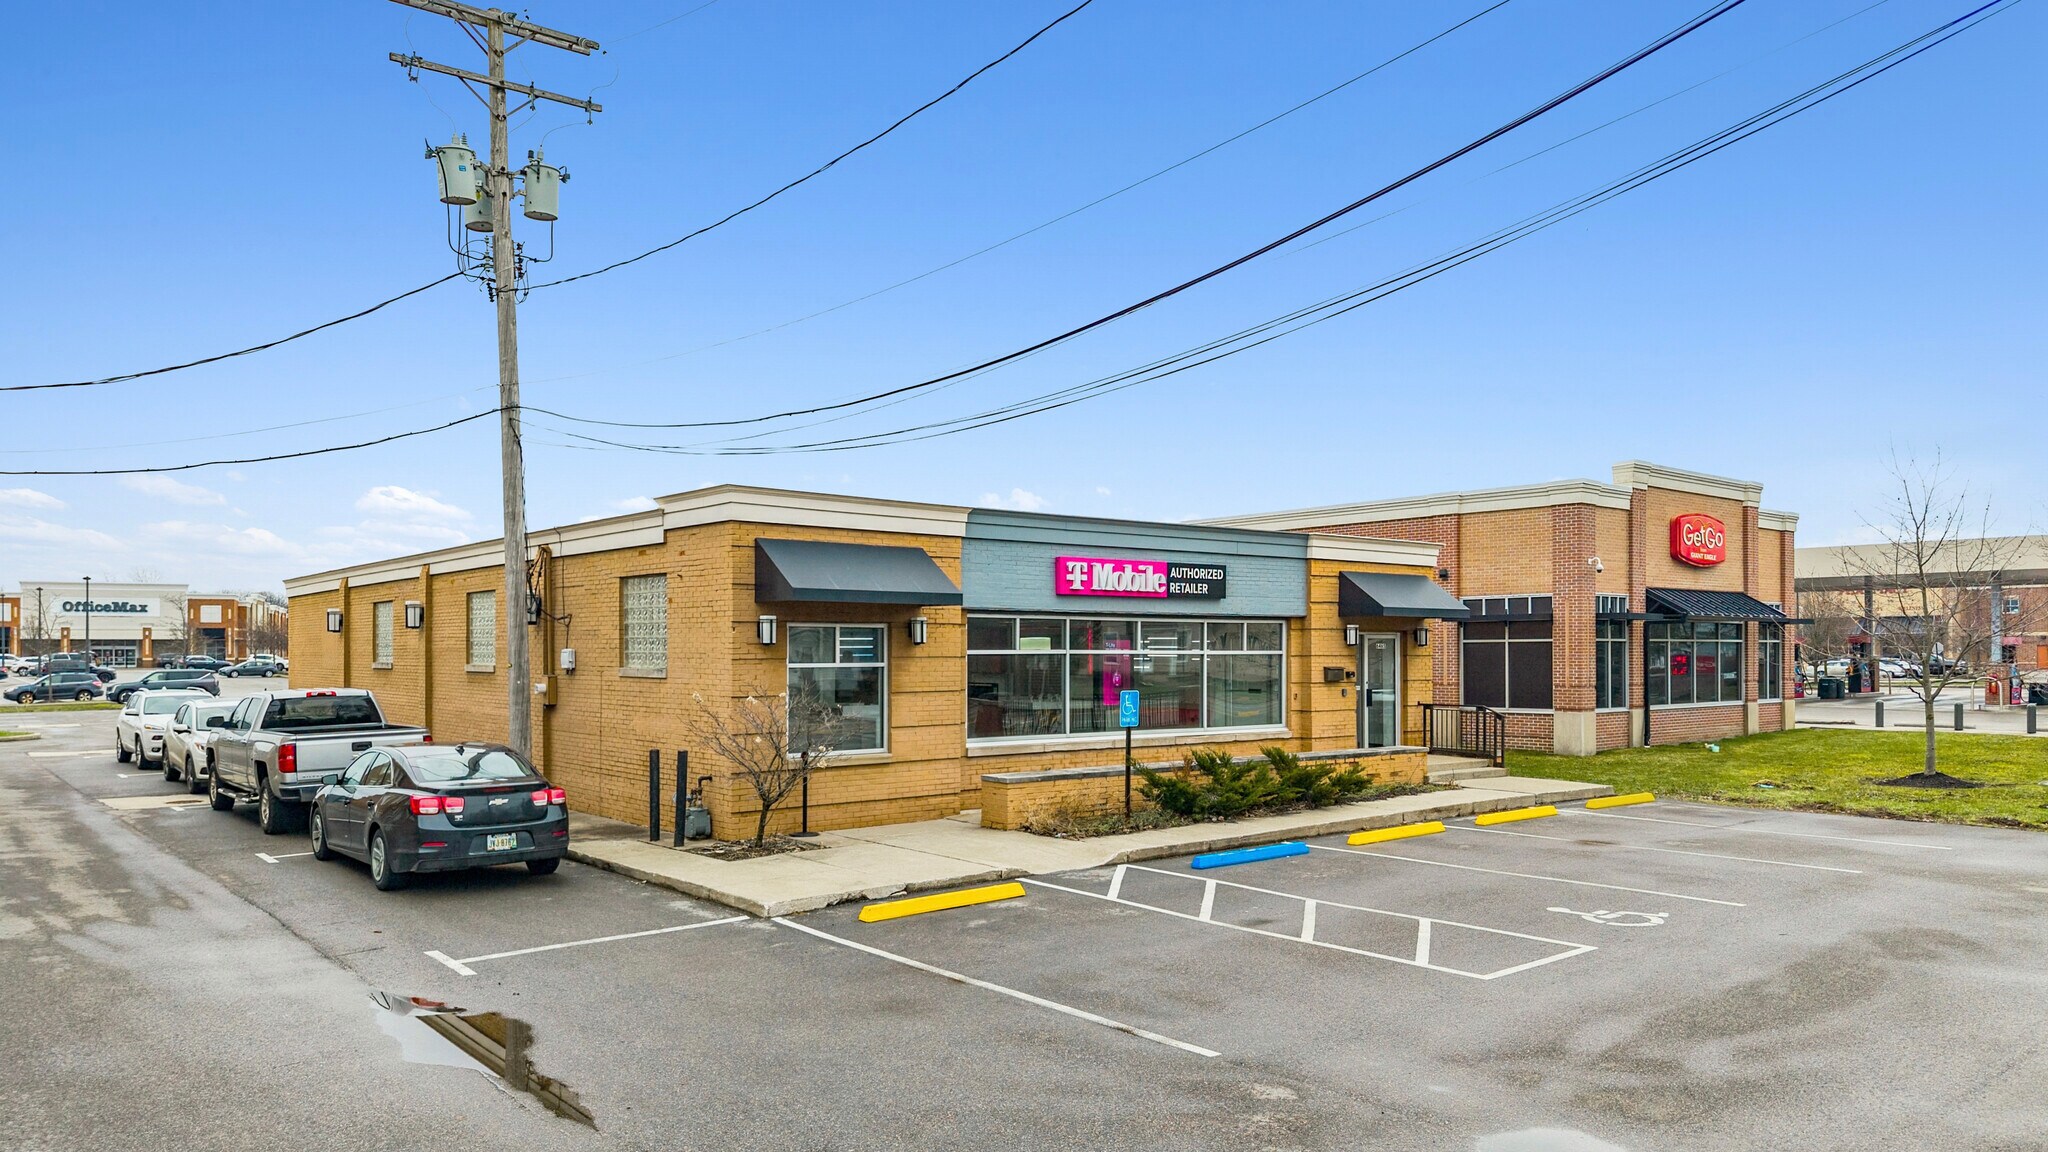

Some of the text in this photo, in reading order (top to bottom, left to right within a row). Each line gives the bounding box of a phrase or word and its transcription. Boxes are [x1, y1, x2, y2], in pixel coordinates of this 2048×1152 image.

[1683, 524, 1723, 548] GetGo
[1170, 568, 1223, 579] AUTHORIZED
[1170, 582, 1208, 594] RETAILER
[62, 601, 148, 613] OfficeMax
